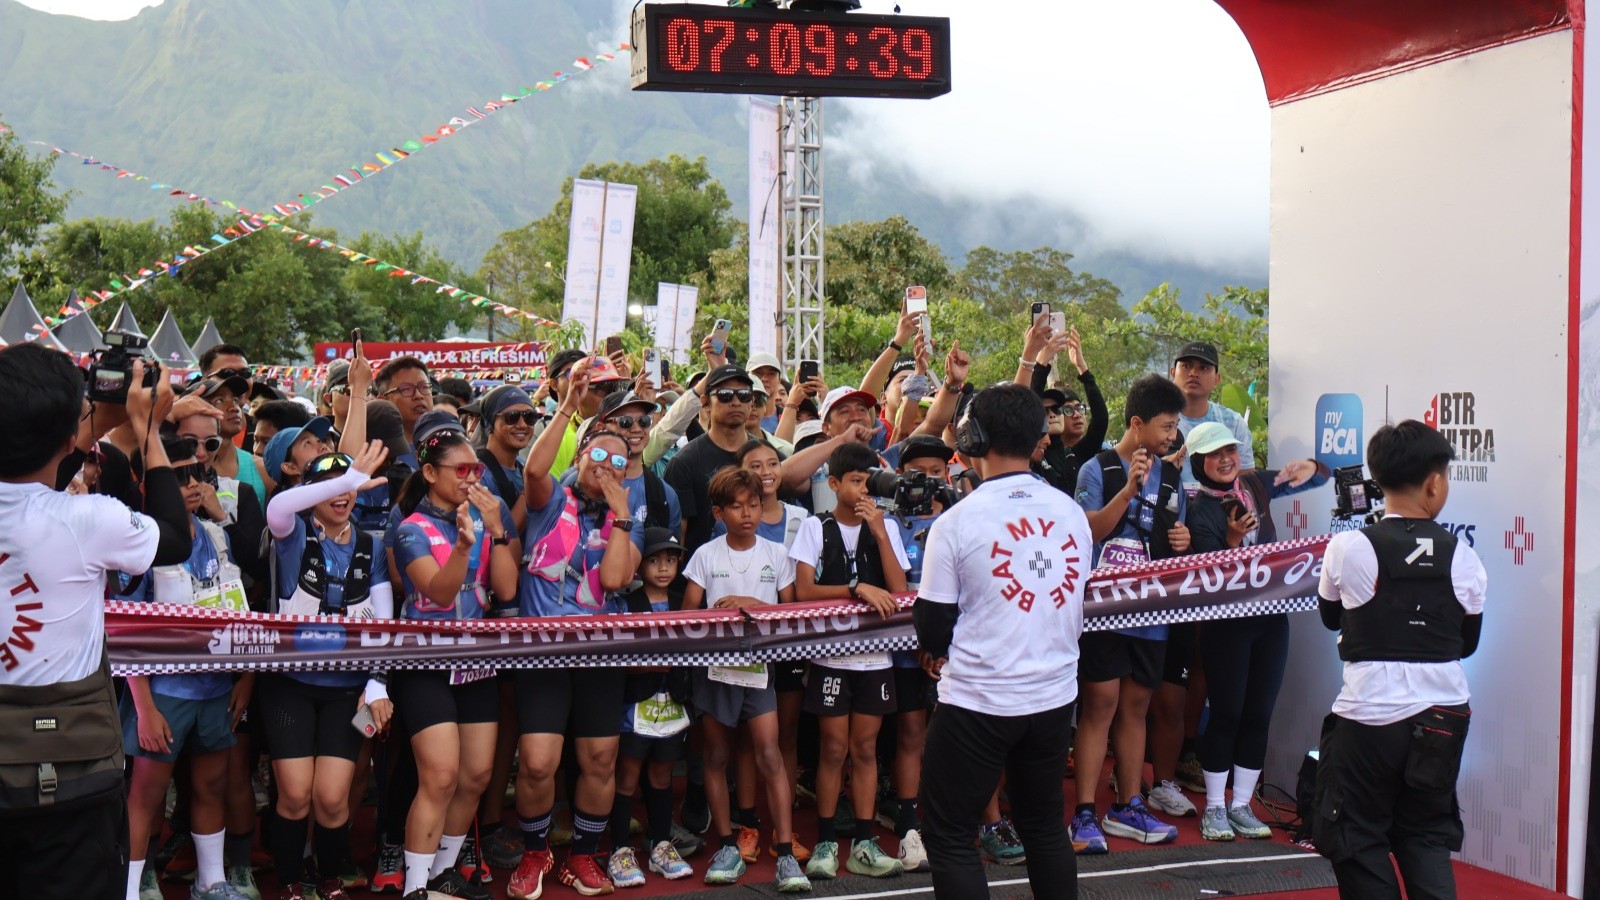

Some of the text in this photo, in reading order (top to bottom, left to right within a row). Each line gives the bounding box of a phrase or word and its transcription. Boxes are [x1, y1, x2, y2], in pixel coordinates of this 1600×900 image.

[667, 18, 932, 79] 07:09:39
[461, 350, 547, 363] REFRESHM
[1324, 411, 1343, 428] my
[1440, 391, 1475, 425] BTR
[1320, 427, 1358, 455] BCA
[1448, 465, 1488, 482] T.BATUR
[990, 517, 1080, 613] BEAT MY TIME
[1178, 554, 1272, 596] 2026
[0, 572, 44, 672] TIME
[822, 676, 842, 695] 26
